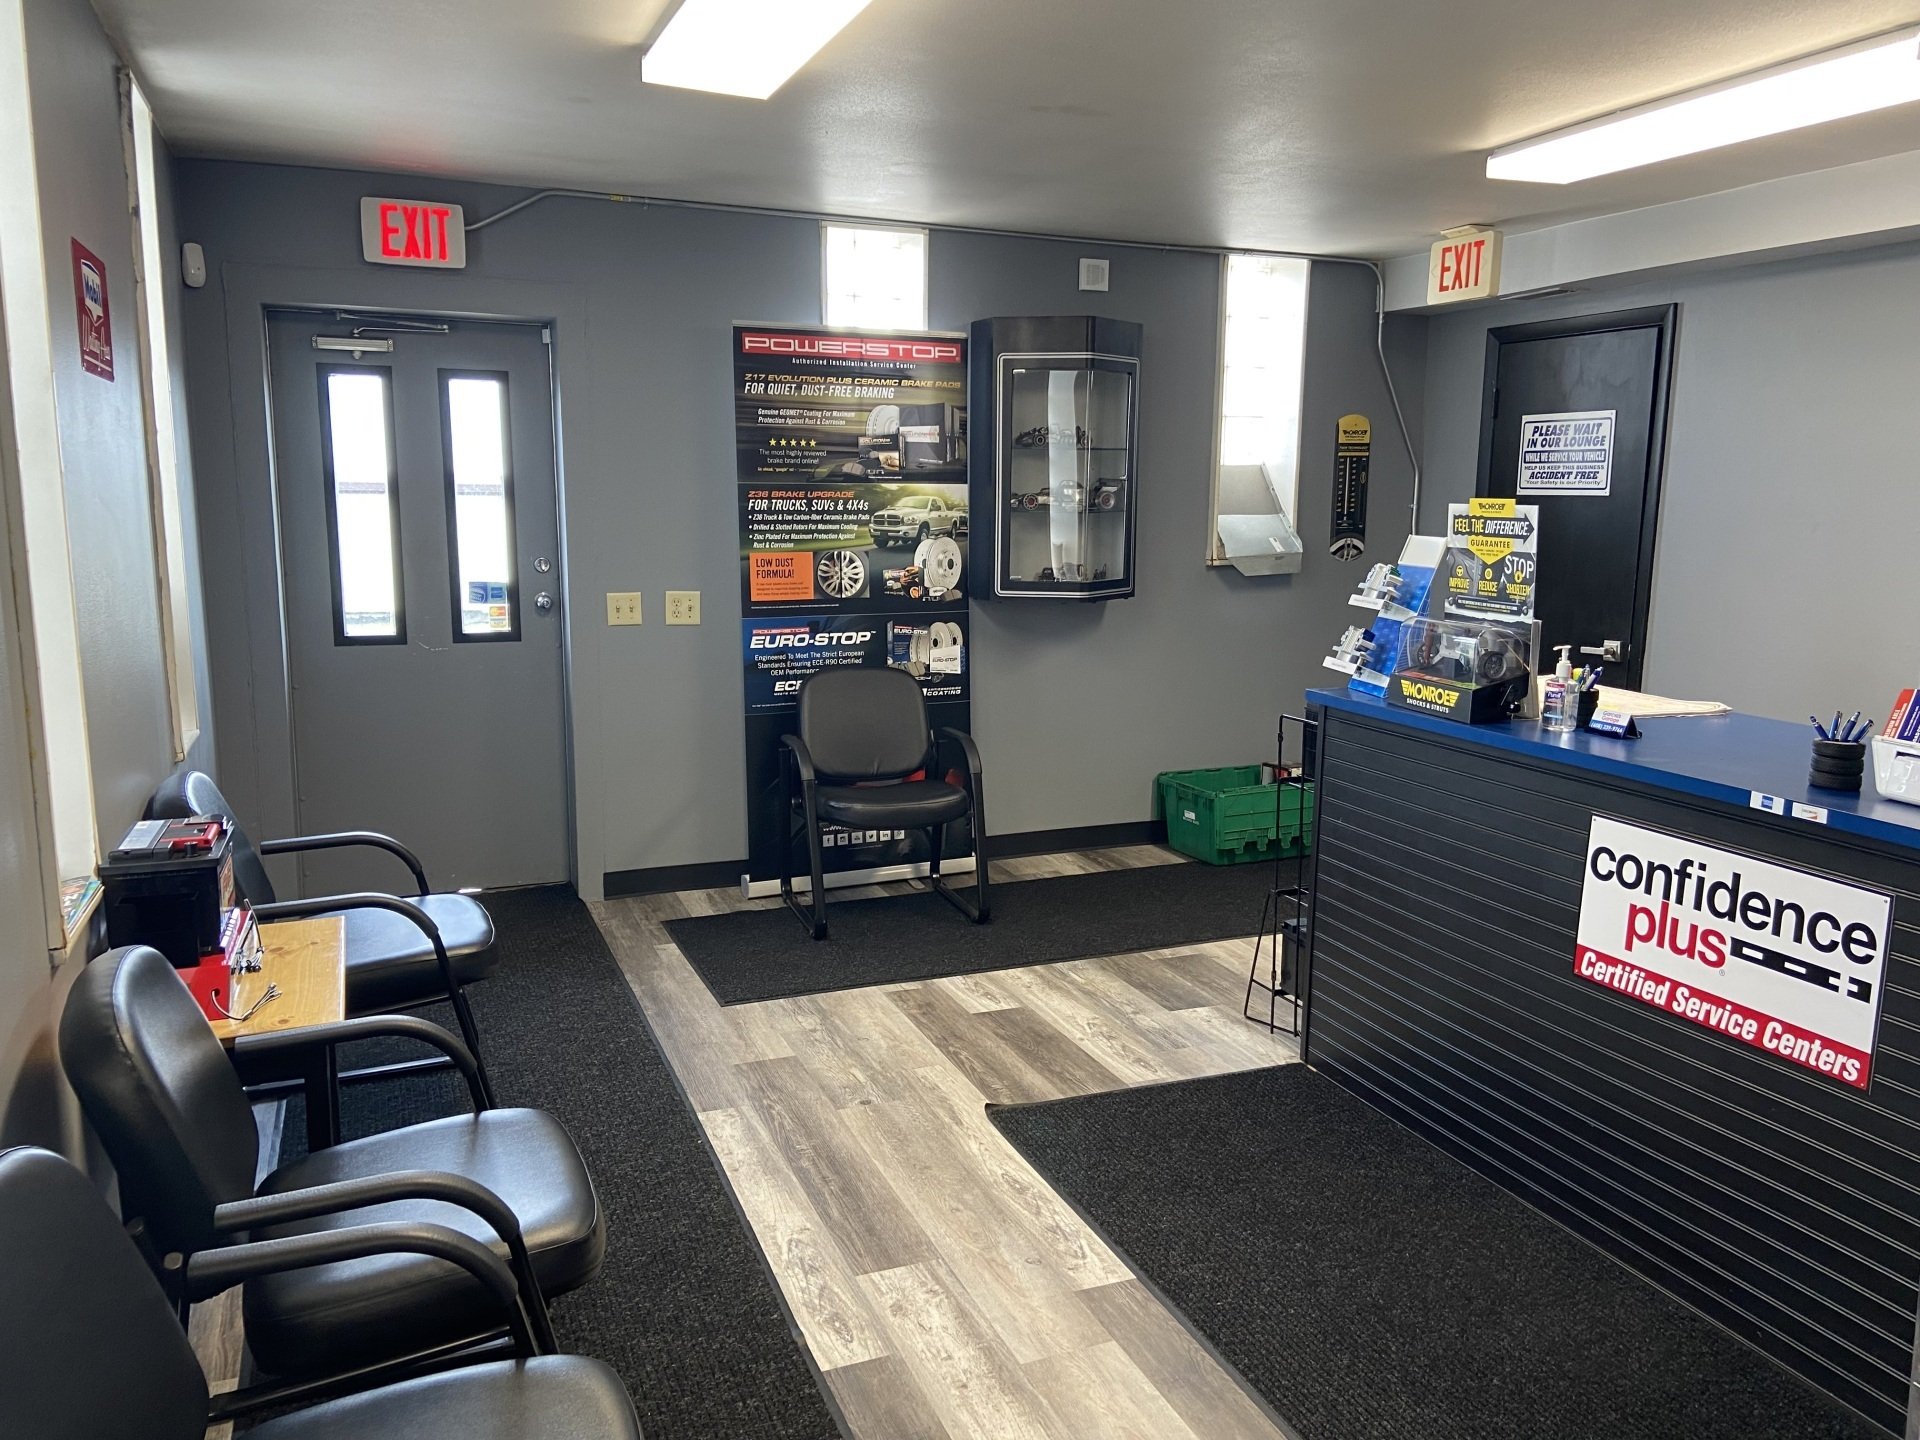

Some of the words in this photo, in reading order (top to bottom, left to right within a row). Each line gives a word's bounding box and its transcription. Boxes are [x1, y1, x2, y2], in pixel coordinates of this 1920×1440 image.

[380, 203, 451, 262] EXIT
[1438, 239, 1486, 293] EXIT
[83, 273, 102, 307] Mobil
[744, 337, 957, 358] POWERSTOP
[792, 357, 827, 366] Authorized
[829, 358, 868, 367] Installation
[869, 360, 893, 369] Service
[896, 361, 916, 370] Center
[744, 373, 766, 381] Z17
[767, 374, 824, 383] EVOLUTION
[826, 376, 852, 385] PLUS
[854, 378, 899, 387] CERAMIC
[901, 379, 934, 388] BRAKE
[935, 381, 961, 389] PADS
[744, 382, 765, 395] FOR
[767, 383, 798, 397] QUIET,
[801, 384, 853, 398] DUST-FREE
[854, 386, 895, 399] BRAKING
[757, 408, 779, 416] Genuine
[803, 409, 822, 418] Coating
[757, 416, 786, 425] Protection
[785, 417, 804, 425] Against
[804, 417, 816, 425] Rust
[821, 418, 846, 426] Corrosion
[1532, 424, 1571, 437] PLEASE
[1573, 422, 1603, 436] WAIT
[1526, 437, 1538, 449] IN
[1540, 437, 1562, 448] OUR
[1563, 435, 1607, 448] LOUNGE
[759, 448, 770, 456] The
[786, 449, 803, 458] highly
[1525, 452, 1541, 463] WHILE
[1540, 452, 1549, 462] WE
[1548, 452, 1569, 462] SERVICE
[1568, 452, 1583, 462] YOUR
[1583, 450, 1605, 461] VEHICLE
[1529, 471, 1573, 480] ACCIDENT
[1574, 471, 1600, 480] FREE
[748, 499, 768, 511] FOR
[771, 499, 809, 512] TRUCKS,
[811, 499, 835, 511] SUVs
[836, 500, 844, 511] &
[846, 499, 869, 511] 4X4s
[1478, 502, 1506, 511] MONROE
[753, 523, 770, 531] Drilled
[775, 523, 793, 531] Slotted
[792, 523, 808, 531] Rotors
[1454, 518, 1470, 532] FEEL
[1471, 518, 1485, 532] THE
[1485, 519, 1530, 536] DIFFERENCE.
[753, 533, 765, 541] Zinc
[765, 533, 781, 541] Plated
[812, 532, 838, 540] Protection
[838, 532, 856, 540] Against
[753, 541, 765, 549] Rust
[770, 541, 794, 549] Corrosion
[1470, 539, 1511, 549] GUARANTEE
[755, 558, 773, 568] LOW
[775, 557, 794, 568] DUST
[1504, 555, 1534, 579] STOP
[756, 569, 795, 579] FORMULA!
[1448, 577, 1470, 589] IMPROVE
[1478, 581, 1498, 592] REDUCE
[1506, 583, 1530, 595] SHORTEN
[754, 654, 786, 662] Engineered
[838, 650, 865, 658] European
[787, 660, 811, 668] Ensuring
[926, 689, 962, 697] COATING
[1403, 680, 1457, 707] MONROE
[1406, 697, 1426, 708] SHOCKS
[1431, 703, 1449, 714] STRUTS
[1590, 846, 1878, 965] confidence
[1624, 900, 1728, 969] plus
[1580, 951, 1671, 1005] Certified
[1673, 986, 1759, 1040] Service
[1762, 1021, 1859, 1082] Centers
